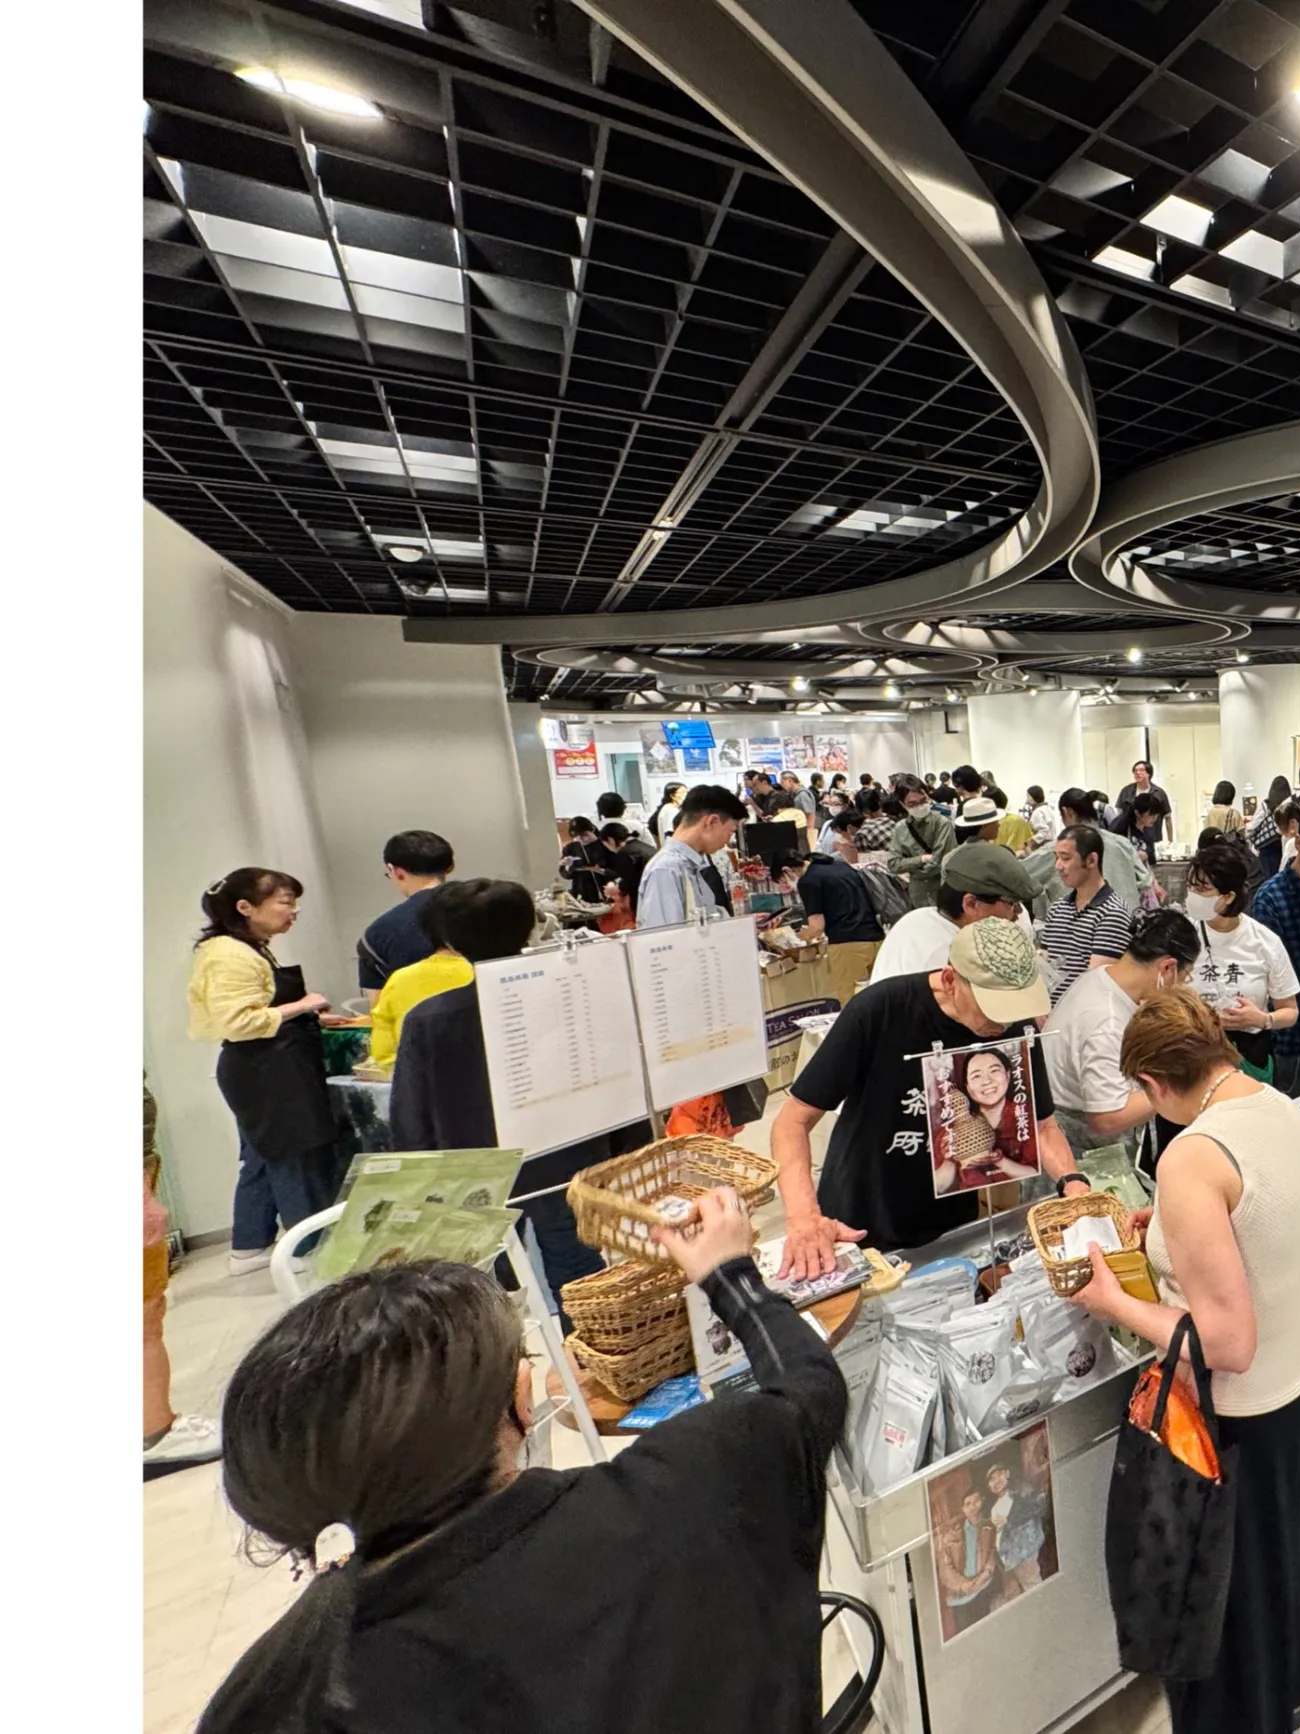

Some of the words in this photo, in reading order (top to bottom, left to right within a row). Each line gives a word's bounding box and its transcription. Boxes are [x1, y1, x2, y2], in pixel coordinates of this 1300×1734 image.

[766, 1020, 789, 1035] TEA
[937, 1068, 958, 1158] おすすめですよ
[1010, 1055, 1030, 1142] ラオスの紅茶は
